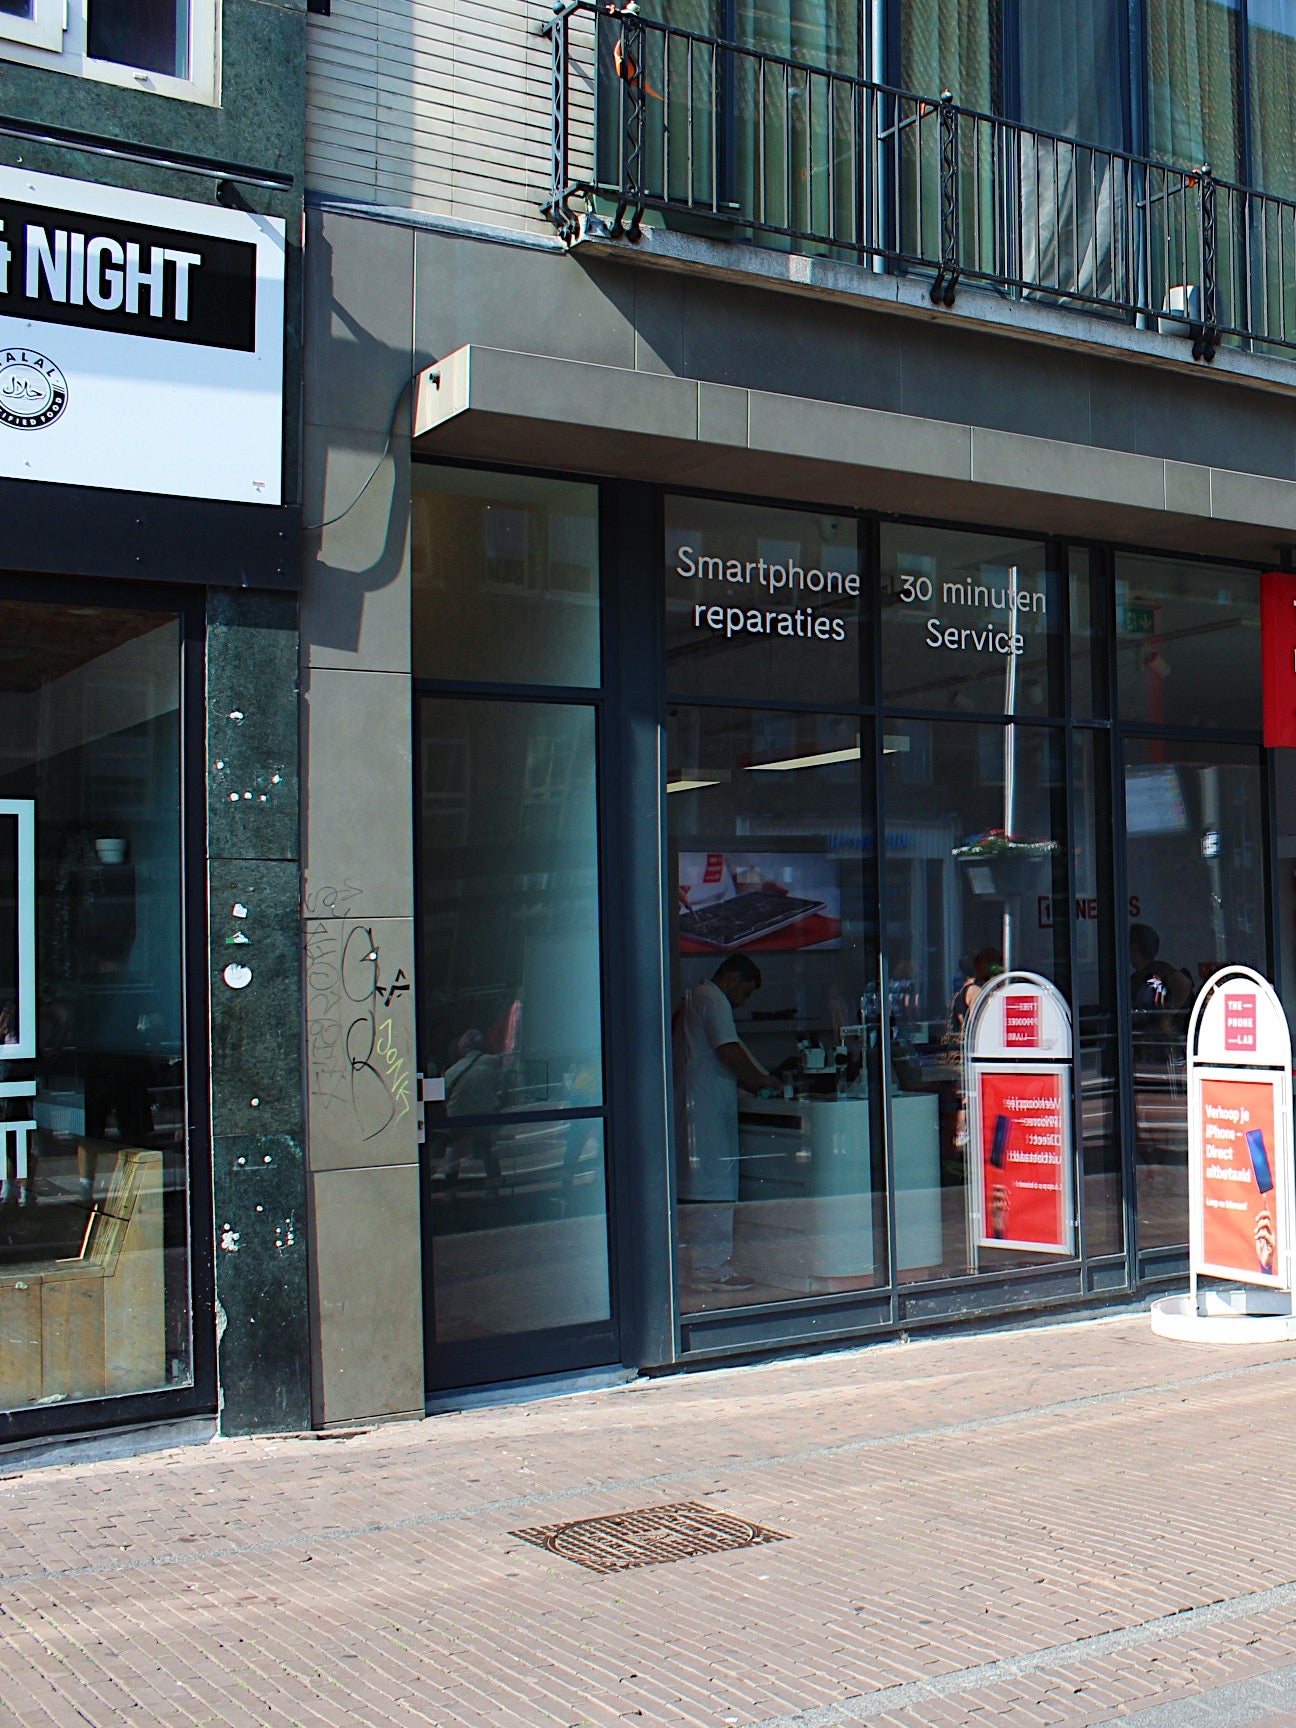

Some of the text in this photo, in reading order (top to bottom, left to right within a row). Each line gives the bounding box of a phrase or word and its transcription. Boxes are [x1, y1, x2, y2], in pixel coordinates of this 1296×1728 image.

[24, 223, 201, 322] NIGHT
[0, 352, 55, 377] ALAL
[40, 397, 62, 423] FOOD
[676, 545, 861, 597] Smartphone
[899, 574, 1047, 614] 30 minuten
[693, 602, 846, 642] reparaties
[925, 617, 1025, 655] Service
[1227, 1000, 1243, 1011] THE
[1227, 1017, 1253, 1028] PHONE
[1237, 1034, 1254, 1045] LAB
[1205, 1104, 1250, 1124] Verkoop je
[1205, 1124, 1236, 1141] iPhone
[1206, 1143, 1234, 1161] Direct
[1206, 1164, 1252, 1183] uitbetaald
